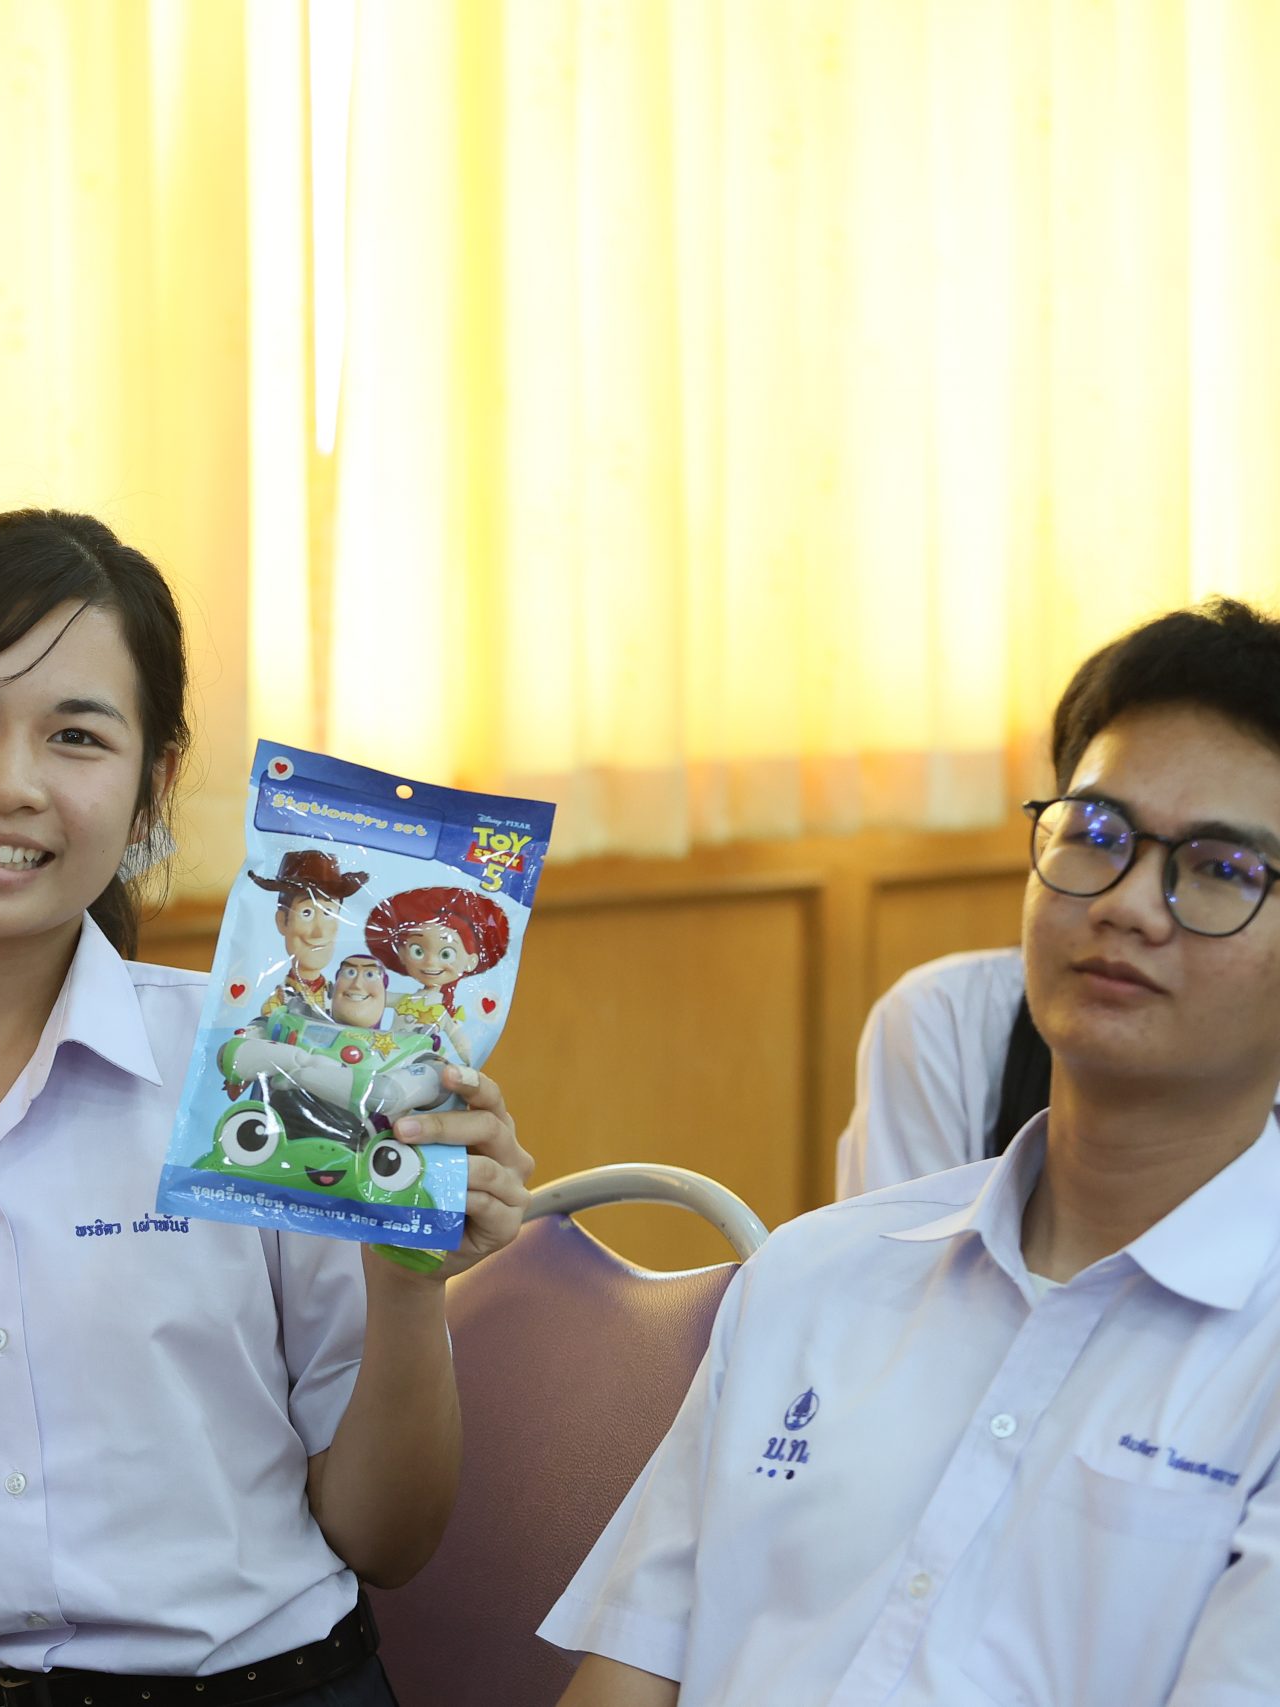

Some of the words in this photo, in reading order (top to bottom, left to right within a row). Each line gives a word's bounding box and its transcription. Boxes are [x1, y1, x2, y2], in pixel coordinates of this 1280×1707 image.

[272, 793, 389, 829] Stationery
[393, 822, 428, 836] set
[505, 820, 531, 830] PIXAR
[472, 826, 533, 854] TOY
[480, 863, 503, 892] 5
[191, 1183, 285, 1209] ชุดเครื่องเขียน
[350, 1213, 378, 1227] ทอย
[422, 1223, 433, 1235] 5
